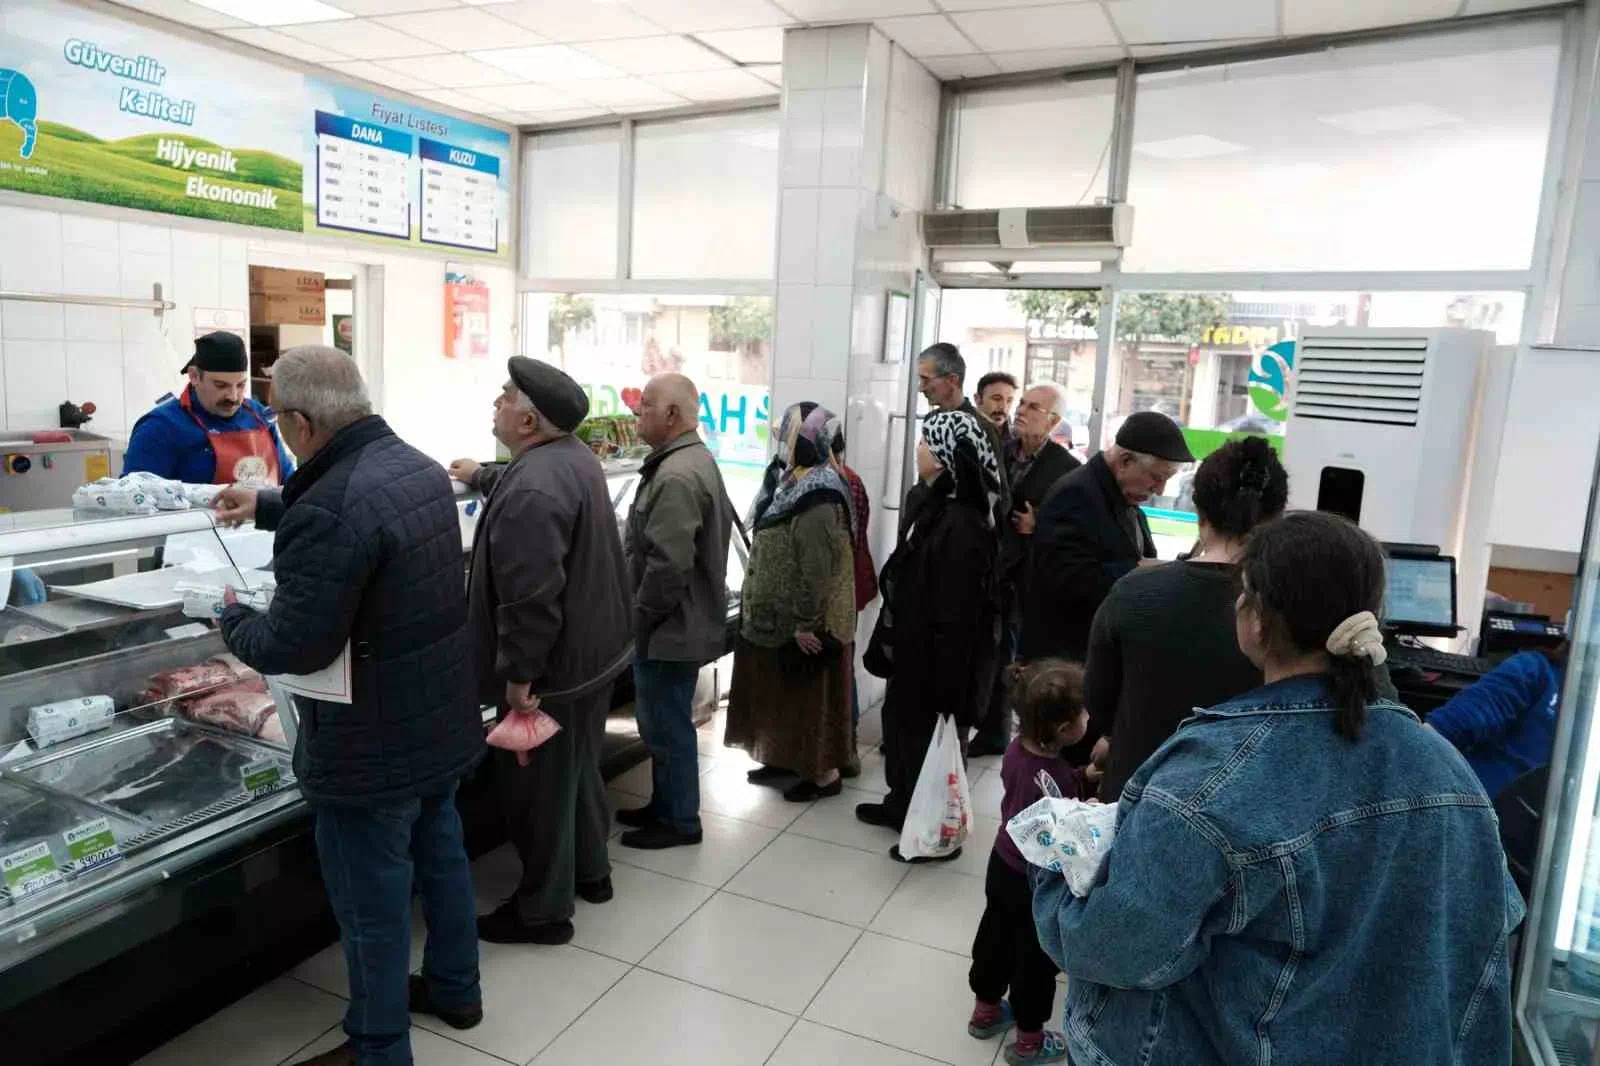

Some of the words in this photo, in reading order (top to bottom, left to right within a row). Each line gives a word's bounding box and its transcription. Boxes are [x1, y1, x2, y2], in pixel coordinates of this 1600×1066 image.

[64, 38, 166, 86] Güvenilir
[119, 87, 195, 126] Kaliteli
[371, 103, 404, 125] Fiyat
[407, 113, 448, 137] Listesi
[351, 123, 383, 144] DANA
[156, 138, 237, 173] Hijyenik
[449, 149, 477, 167] KUZU
[186, 176, 278, 209] Ekonomik
